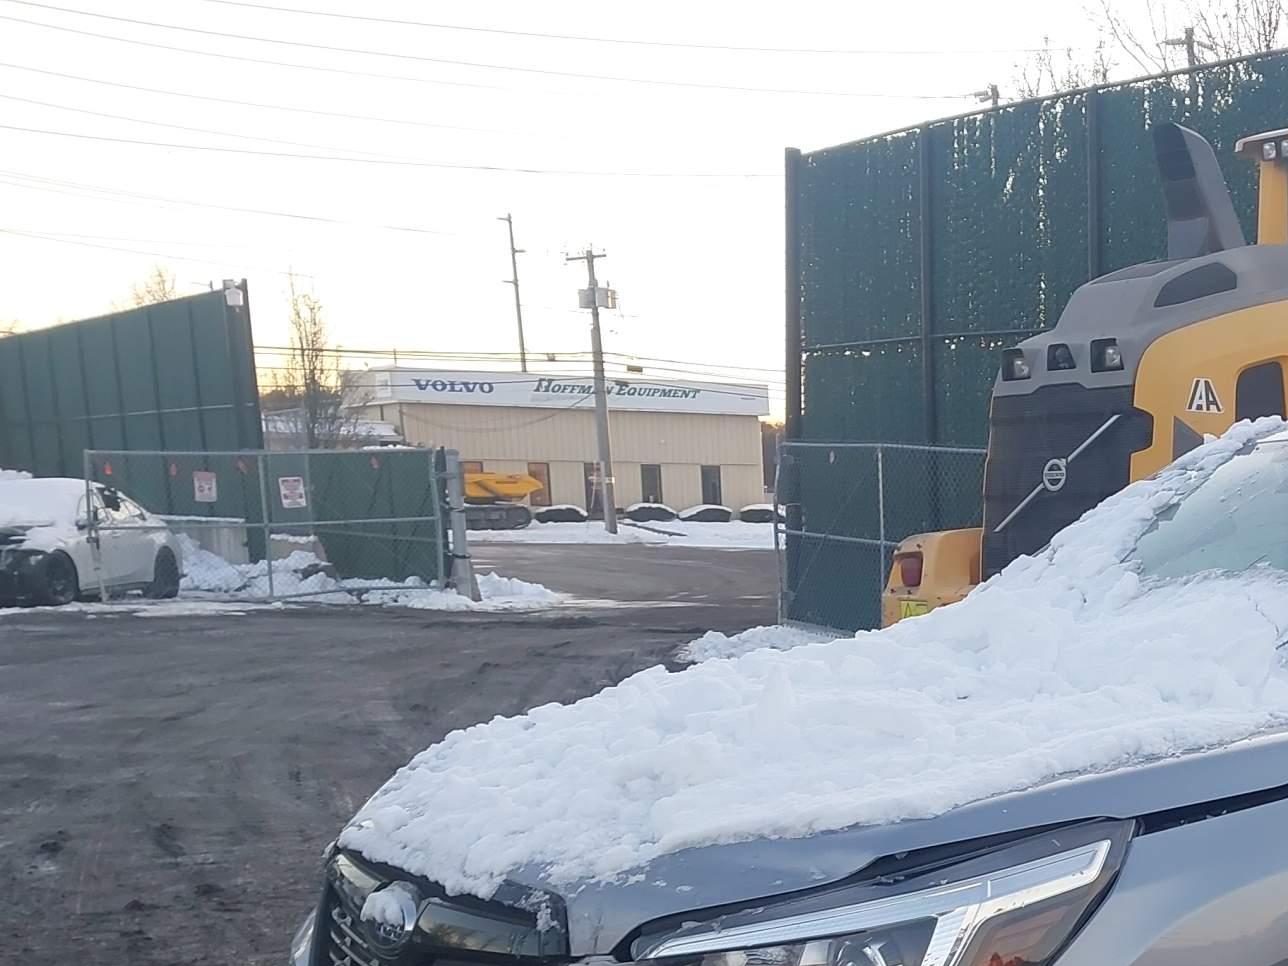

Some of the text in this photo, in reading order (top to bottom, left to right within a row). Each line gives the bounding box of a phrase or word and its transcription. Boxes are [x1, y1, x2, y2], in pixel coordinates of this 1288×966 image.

[411, 378, 494, 393] VOLVO
[533, 378, 701, 399] HOFFMN EQUIPMENT
